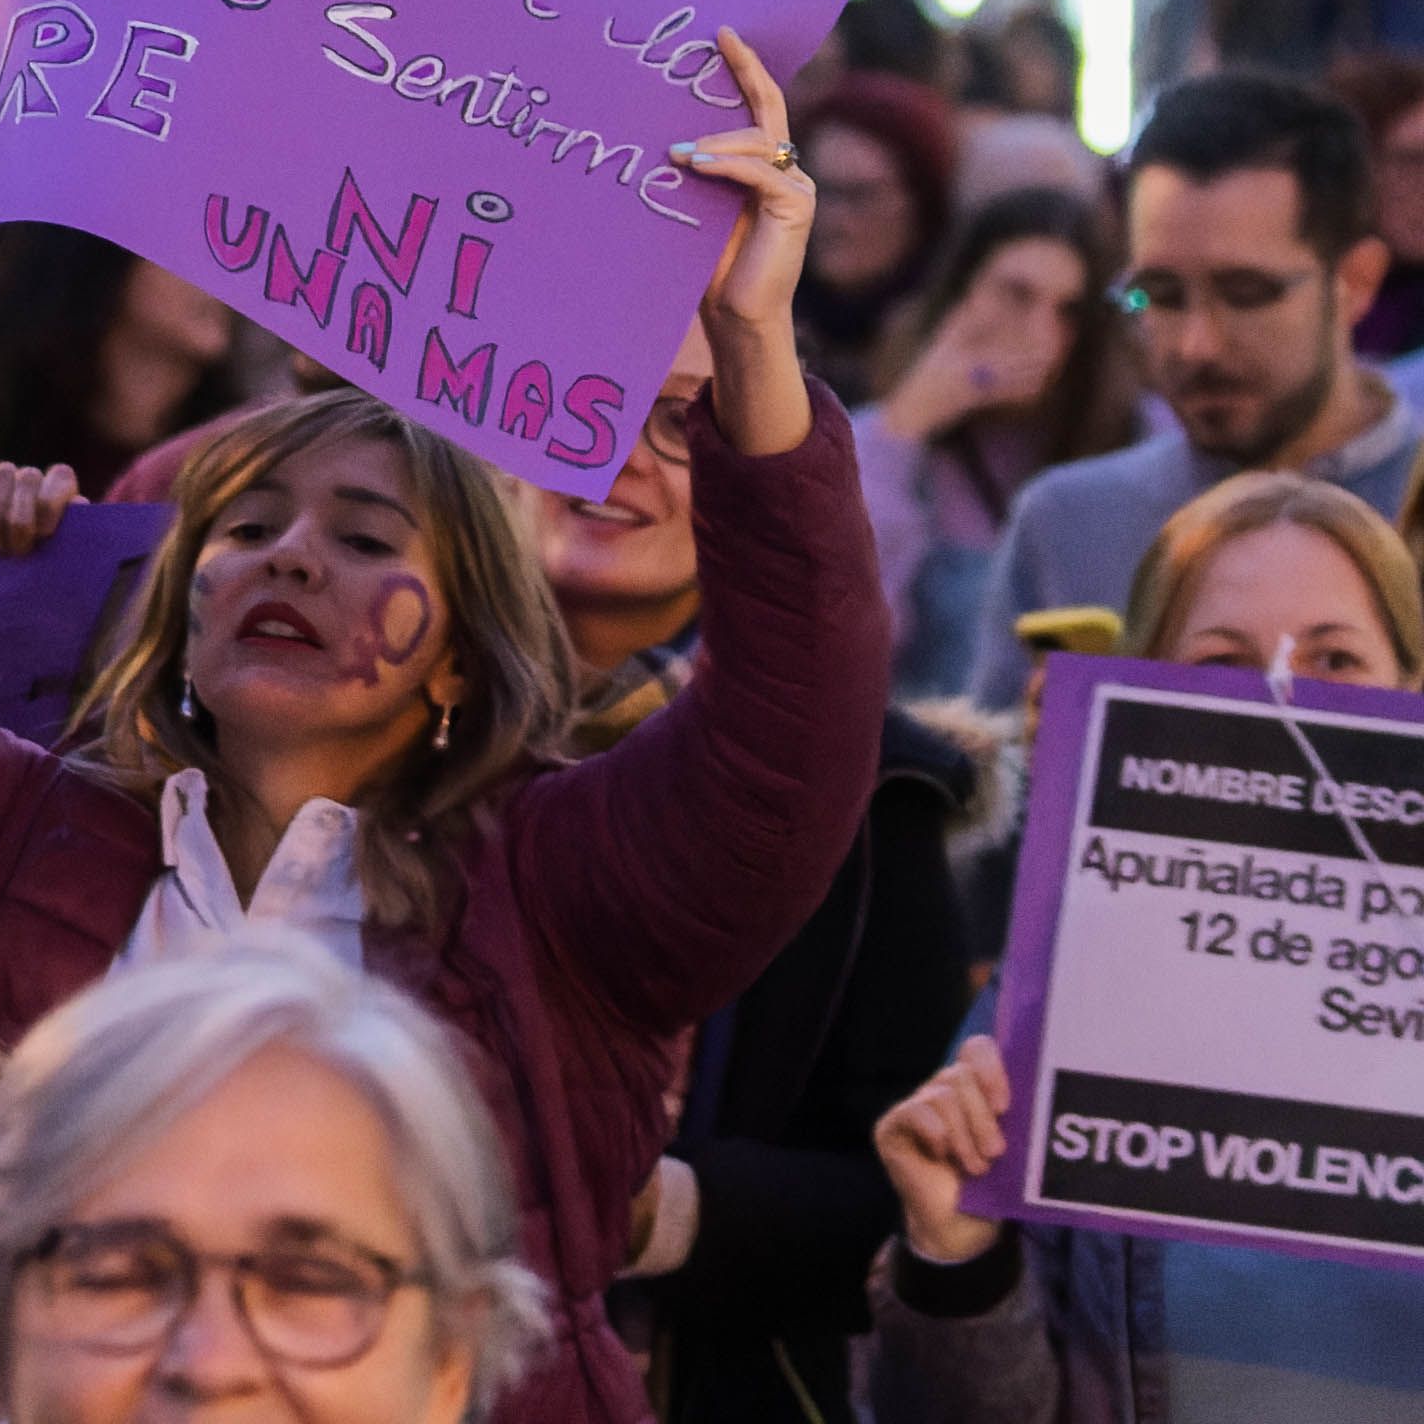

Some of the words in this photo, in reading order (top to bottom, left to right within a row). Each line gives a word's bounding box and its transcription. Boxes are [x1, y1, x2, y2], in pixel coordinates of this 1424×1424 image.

[604, 6, 743, 108] la
[322, 2, 701, 229] Sentirme
[204, 192, 393, 373] UNA
[416, 325, 626, 469] MAS
[1120, 755, 1304, 809] NOMBRE
[1082, 835, 1346, 910] Apuñalada
[1179, 910, 1236, 956] 12
[1250, 919, 1312, 965] de
[1052, 1113, 1195, 1171] STOP
